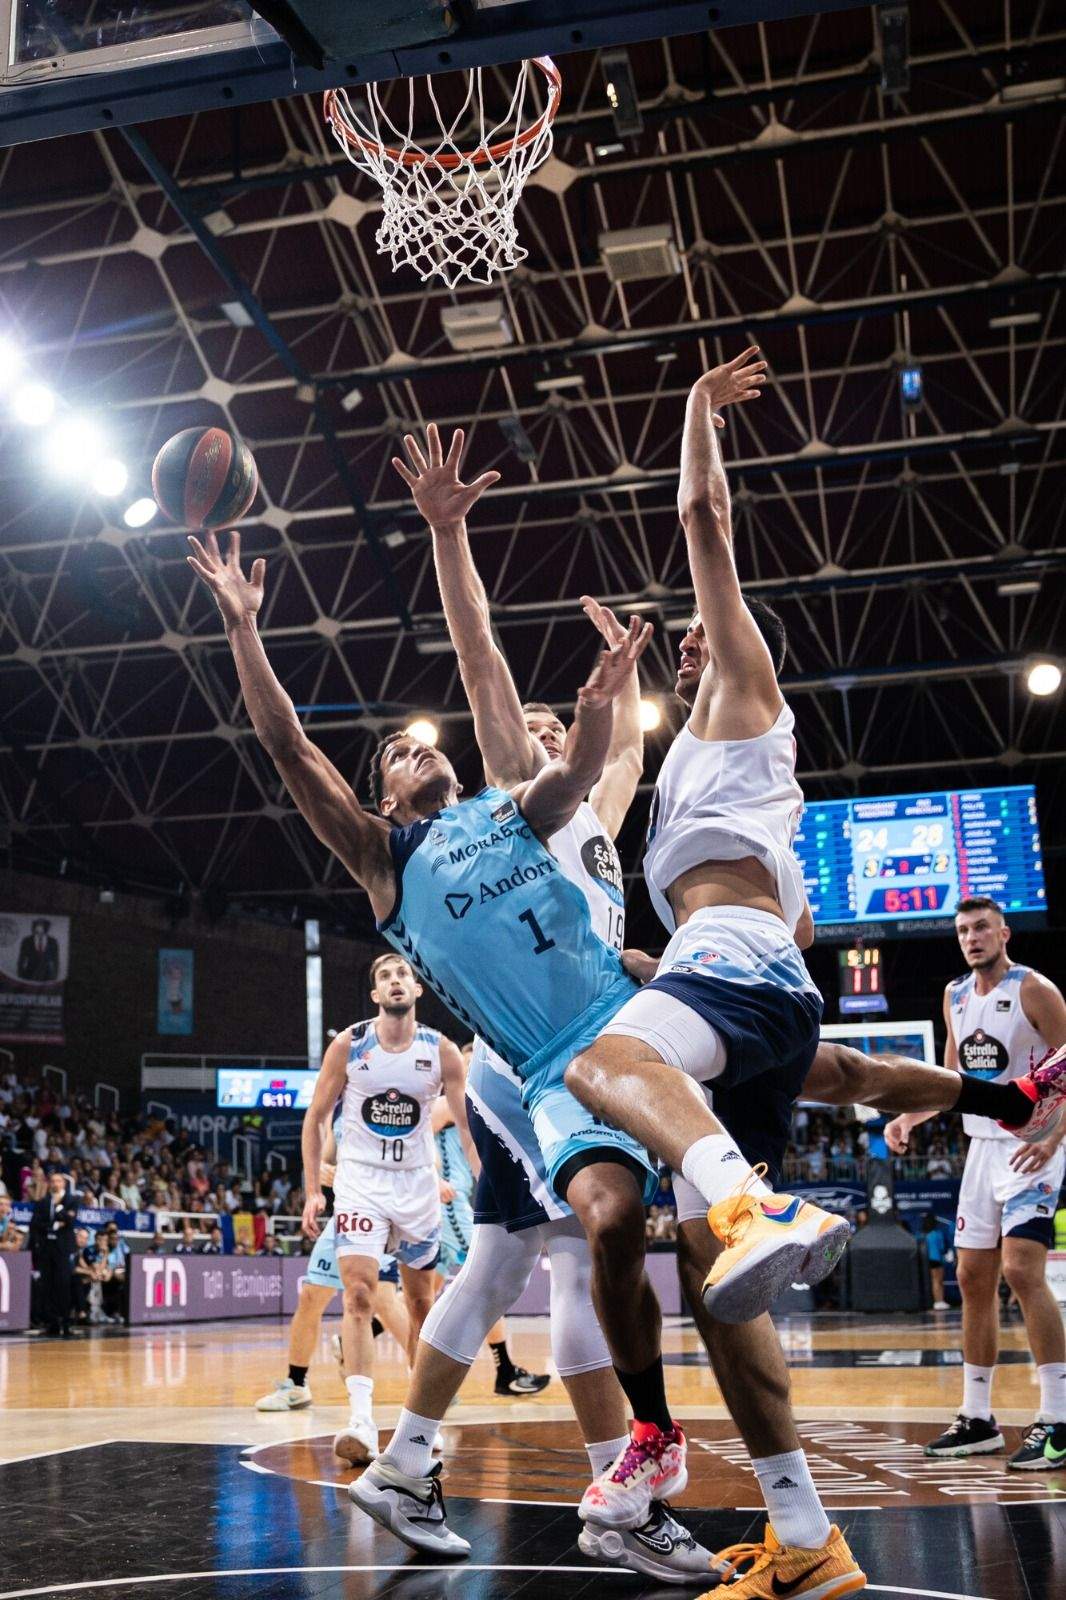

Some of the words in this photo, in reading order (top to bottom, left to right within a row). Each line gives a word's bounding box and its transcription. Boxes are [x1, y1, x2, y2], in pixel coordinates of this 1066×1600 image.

[856, 827, 888, 853] 24
[910, 824, 944, 849] 28
[518, 908, 556, 955] 1
[963, 1043, 998, 1056] Estrella
[966, 1057, 997, 1069] Galicia
[370, 1098, 413, 1113] Estrella
[371, 1110, 412, 1126] Galicia
[380, 1138, 404, 1162] 10
[336, 1212, 373, 1234] Río
